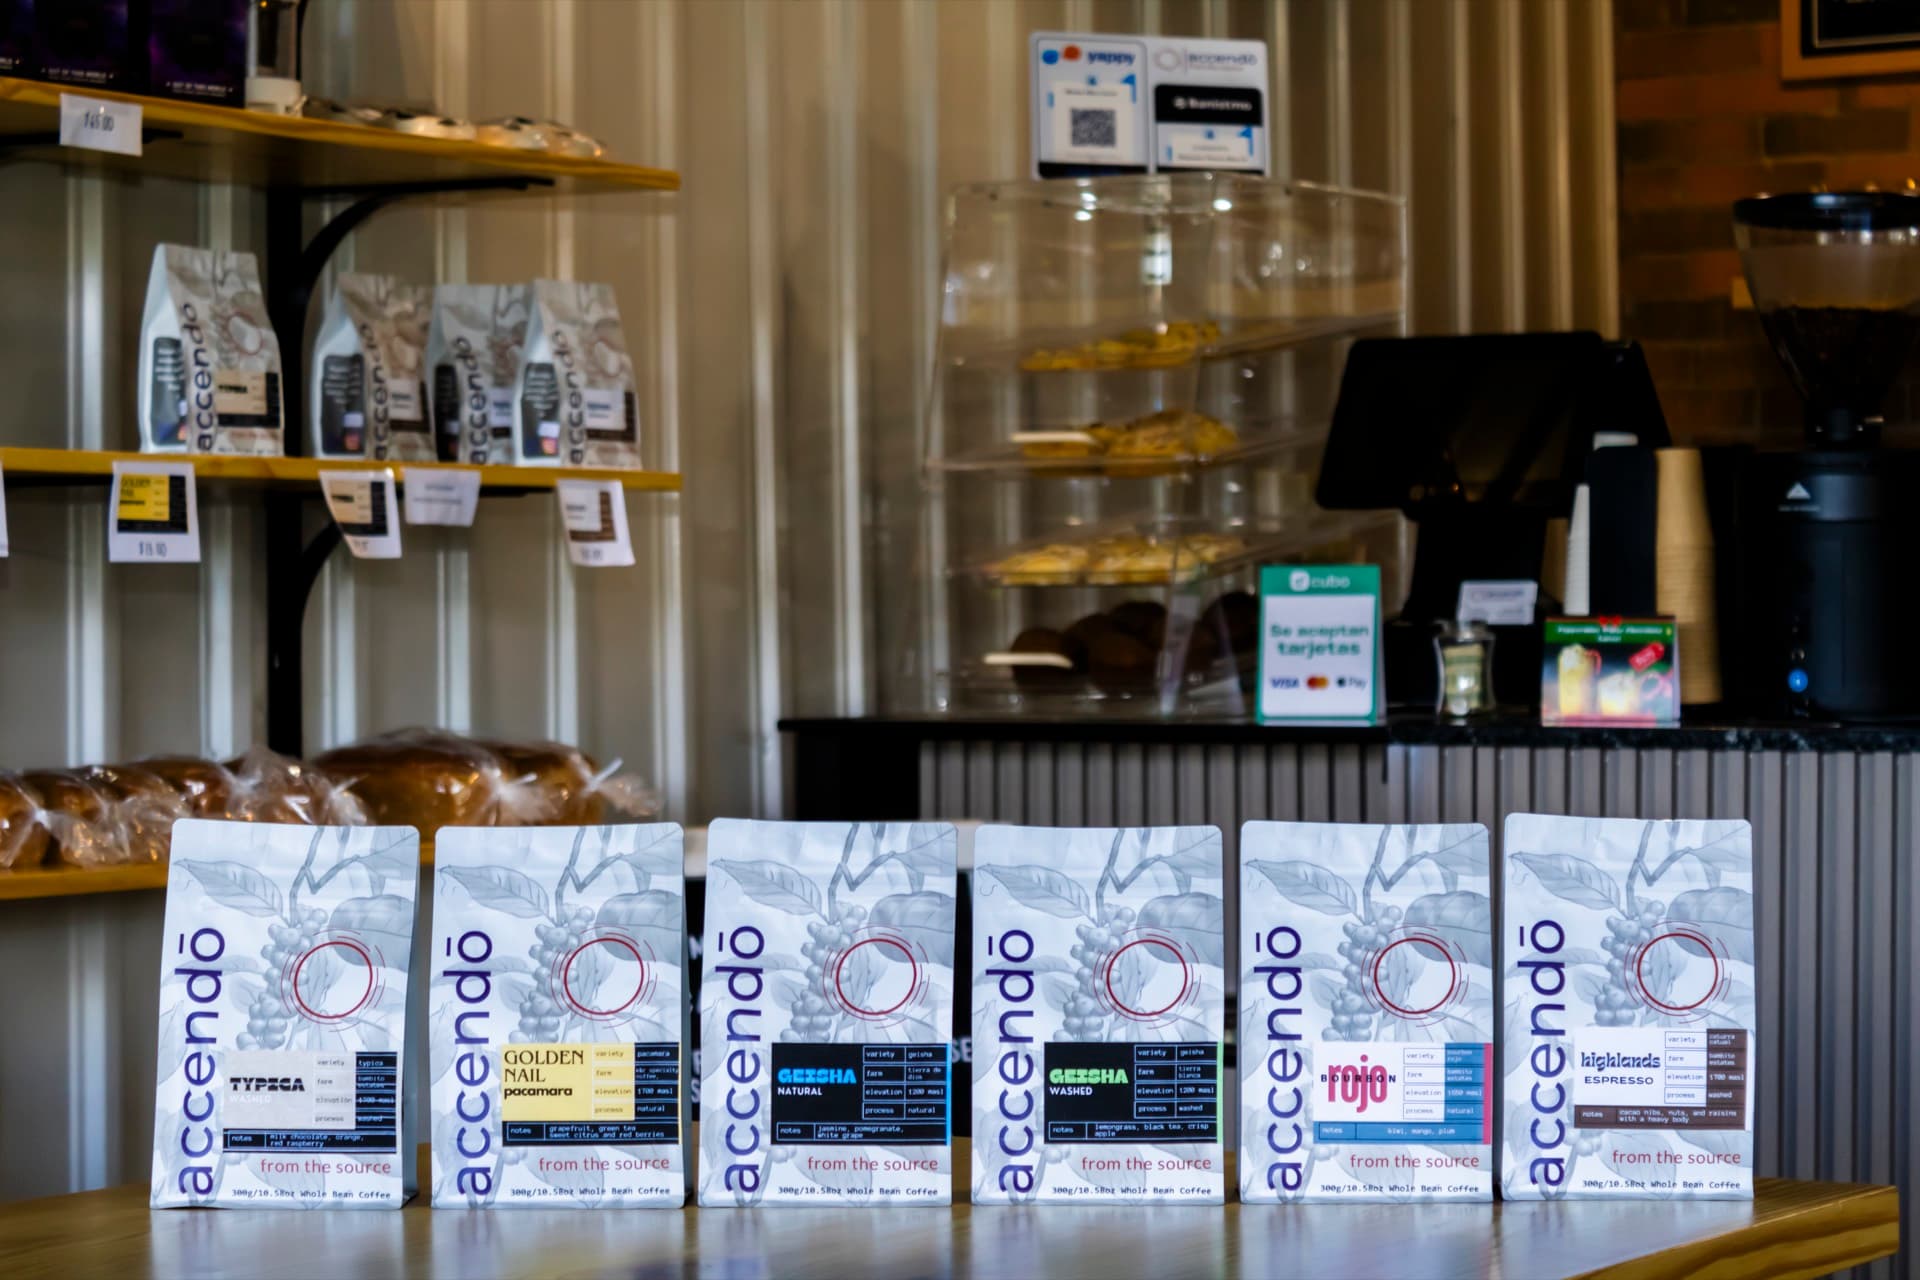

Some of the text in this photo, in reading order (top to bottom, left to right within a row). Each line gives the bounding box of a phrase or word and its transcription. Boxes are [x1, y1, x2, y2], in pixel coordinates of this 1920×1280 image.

[1088, 51, 1136, 66] yappy
[1310, 574, 1351, 588] cubo
[1271, 624, 1369, 640] Se aceptan
[1277, 642, 1361, 660] tarjetas
[1271, 677, 1299, 688] VISA
[1668, 1036, 1696, 1044] variety
[504, 1050, 584, 1065] GOLDEN
[866, 1051, 895, 1059] variety
[908, 1051, 933, 1059] geisha
[1138, 1049, 1167, 1057] variety
[1180, 1049, 1205, 1057] geisha
[1581, 1052, 1661, 1072] highlands
[504, 1068, 546, 1083] NAIL
[778, 1068, 857, 1084] GEISHA
[1050, 1069, 1128, 1084] GEISHA
[1320, 1074, 1397, 1083] BOURBON
[1584, 1076, 1654, 1085] ESPRESSO
[230, 1077, 305, 1092] TYPICA
[1328, 1054, 1388, 1113] rojo
[504, 1087, 573, 1100] pacamara
[777, 1087, 823, 1096] NATURAL
[1050, 1087, 1093, 1096] WASHED
[865, 1107, 894, 1115] process
[908, 1106, 936, 1114] natural
[1178, 1104, 1203, 1112] washed
[1095, 1124, 1139, 1132] lemongrass,
[1351, 1155, 1480, 1168] from the source
[1613, 1151, 1741, 1164] from the source
[260, 1159, 391, 1174] from the source
[539, 1158, 670, 1171] from the source
[808, 1157, 939, 1171] from the source
[1082, 1157, 1212, 1170] from the source
[1389, 1185, 1416, 1193] Whole
[1421, 1185, 1442, 1193] Bean
[1448, 1185, 1479, 1193] Coffee
[1709, 1181, 1741, 1189] Coffee
[300, 1189, 327, 1198] Whole
[332, 1190, 354, 1198] Bean
[358, 1191, 391, 1199] Coffee
[579, 1187, 606, 1195] Whole
[612, 1187, 633, 1195] Bean
[638, 1187, 671, 1195] Coffee
[847, 1187, 874, 1195] Whole
[880, 1187, 901, 1195] Bean
[906, 1187, 938, 1196] Coffee
[1121, 1187, 1148, 1195] Whole
[1153, 1187, 1175, 1195] Bean
[1180, 1187, 1212, 1195] Coffee
